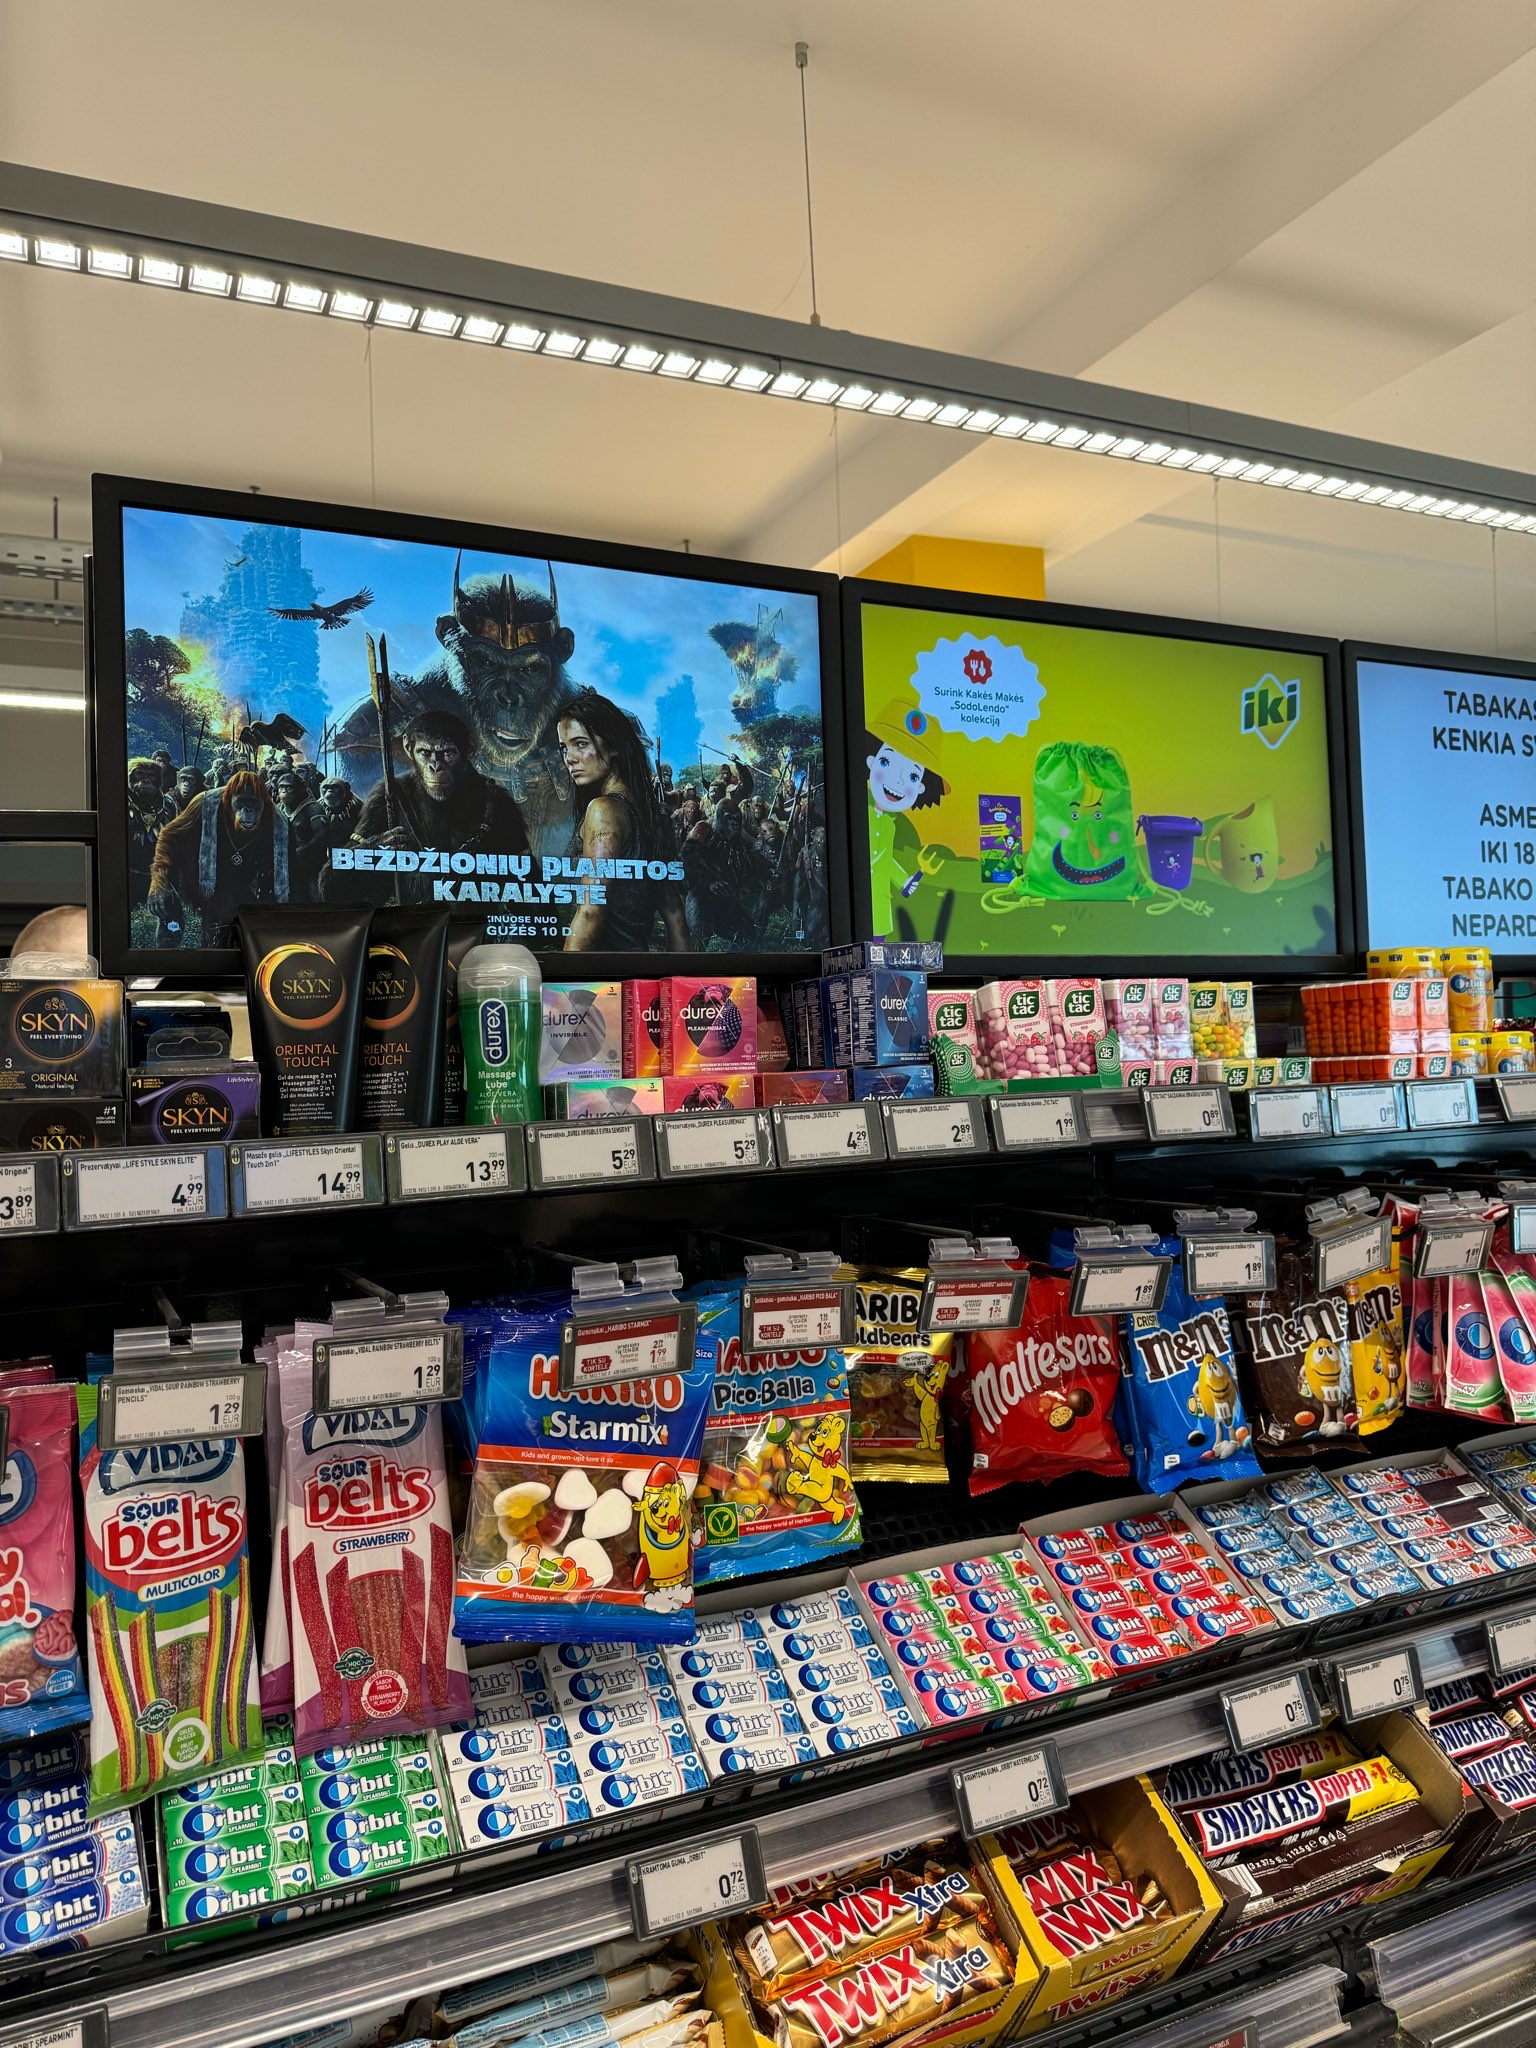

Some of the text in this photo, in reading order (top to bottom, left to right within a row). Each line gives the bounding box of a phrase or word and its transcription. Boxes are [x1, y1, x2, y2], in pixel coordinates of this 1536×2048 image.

[934, 687, 1024, 703] Surink Kakės Makės
[1244, 683, 1297, 731] iki
[961, 713, 1000, 727] kolekciją
[1433, 726, 1536, 757] KENKIA S
[1481, 840, 1535, 865] IKI 18
[331, 845, 686, 881] BEŽDŽIONIŲ PLANETOS
[433, 879, 607, 905] KARALYSTĖ
[1442, 876, 1533, 901] TABAKO
[534, 916, 557, 924] NUO
[541, 926, 558, 937] 10
[1389, 954, 1403, 962] NEW
[282, 978, 332, 995] SKYN
[1130, 985, 1143, 994] tic
[1394, 990, 1408, 999] tac
[1396, 983, 1410, 992] tic
[881, 994, 908, 1010] durex
[1015, 993, 1036, 1006] tic
[1071, 992, 1091, 1005] tic
[1126, 992, 1142, 1001] tac
[1196, 998, 1213, 1007] tac
[1200, 991, 1213, 1000] tic
[680, 1005, 724, 1020] durex
[943, 1004, 962, 1017] tic
[1011, 1002, 1038, 1015] tac
[1068, 1002, 1092, 1013] tac
[21, 1013, 89, 1031] SKYN
[543, 1011, 588, 1027] durex
[939, 1014, 963, 1027] tac
[1014, 1020, 1041, 1030] STRAWBERRY
[1070, 1018, 1097, 1030] STRAWBERRY
[487, 1004, 502, 1060] durex
[275, 1043, 338, 1056] ORIENTAL
[5, 1059, 12, 1068] 3
[284, 1055, 330, 1068] TOUCH
[364, 1054, 403, 1067] TOUCH
[31, 1073, 78, 1082] ORIGINAL
[478, 1070, 517, 1080] Massage
[485, 1080, 508, 1089] Lube
[104, 1106, 116, 1115] #1
[163, 1107, 227, 1126] SKYN
[31, 1134, 83, 1150] SKYN
[401, 1140, 415, 1150] Gelis
[435, 1138, 449, 1147] PLAY
[450, 1137, 464, 1146] ALOE
[320, 1147, 334, 1156] Skyn
[334, 1145, 357, 1155] Oriental
[80, 1162, 122, 1172] Prezervatyvai
[140, 1158, 160, 1168] STYLE
[160, 1157, 177, 1166] SKYN
[246, 1160, 264, 1169] Touch
[187, 1195, 204, 1206] EUR
[15, 1209, 33, 1219] EUR
[696, 1350, 713, 1359] Size
[165, 1377, 241, 1391] SOUR RAINBOW STRAWBERRY
[426, 1377, 441, 1388] EUR
[971, 1333, 1114, 1438] Maltesers
[223, 1413, 240, 1424] EUR
[321, 1405, 410, 1437] VIDAL
[551, 1410, 662, 1446] Starmix
[122, 1438, 219, 1476] VIDAL
[521, 1451, 535, 1459] Kids
[551, 1454, 585, 1462] grown-ups
[319, 1462, 368, 1482] SOUR
[309, 1459, 431, 1524] belts
[122, 1498, 179, 1522] SOUR
[106, 1496, 241, 1569] belts
[756, 1520, 788, 1532] happy world
[339, 1530, 411, 1552] STRAWBERRY
[707, 1536, 739, 1545] VEGETARIAN
[1038, 1535, 1089, 1559] Orbit
[953, 1559, 1006, 1586] Orbit
[146, 1568, 221, 1600] MULTICOLOR
[526, 1592, 548, 1602] happy
[770, 1599, 836, 1630] Orbit
[1197, 1609, 1250, 1637] Orbit
[897, 1637, 954, 1667] Orbit
[680, 1648, 745, 1678] Orbit
[1027, 1661, 1086, 1693] Orbit
[51, 1681, 73, 1693] FREE
[369, 1691, 401, 1701] STRAWBERRY
[579, 1700, 647, 1735] Orbit
[1430, 1713, 1506, 1750] SNICKERS
[460, 1728, 534, 1762] Orbit
[1271, 1739, 1324, 1768] SUPER
[319, 1771, 394, 1809] Orbit
[1203, 1781, 1320, 1848] SNICKERS
[1320, 1772, 1371, 1803] SUPER
[0, 1807, 85, 1854] Orbit
[182, 1803, 264, 1842] Orbit
[642, 1861, 671, 1876] KRAMTOMA
[671, 1857, 686, 1870] GUMA
[901, 1872, 969, 1924] Xtra
[4, 1893, 97, 1944] Orbit
[56, 1912, 97, 1931] WINTERFRESH
[922, 1945, 992, 2003] Xtra
[1048, 1968, 1149, 2021] TWIX
